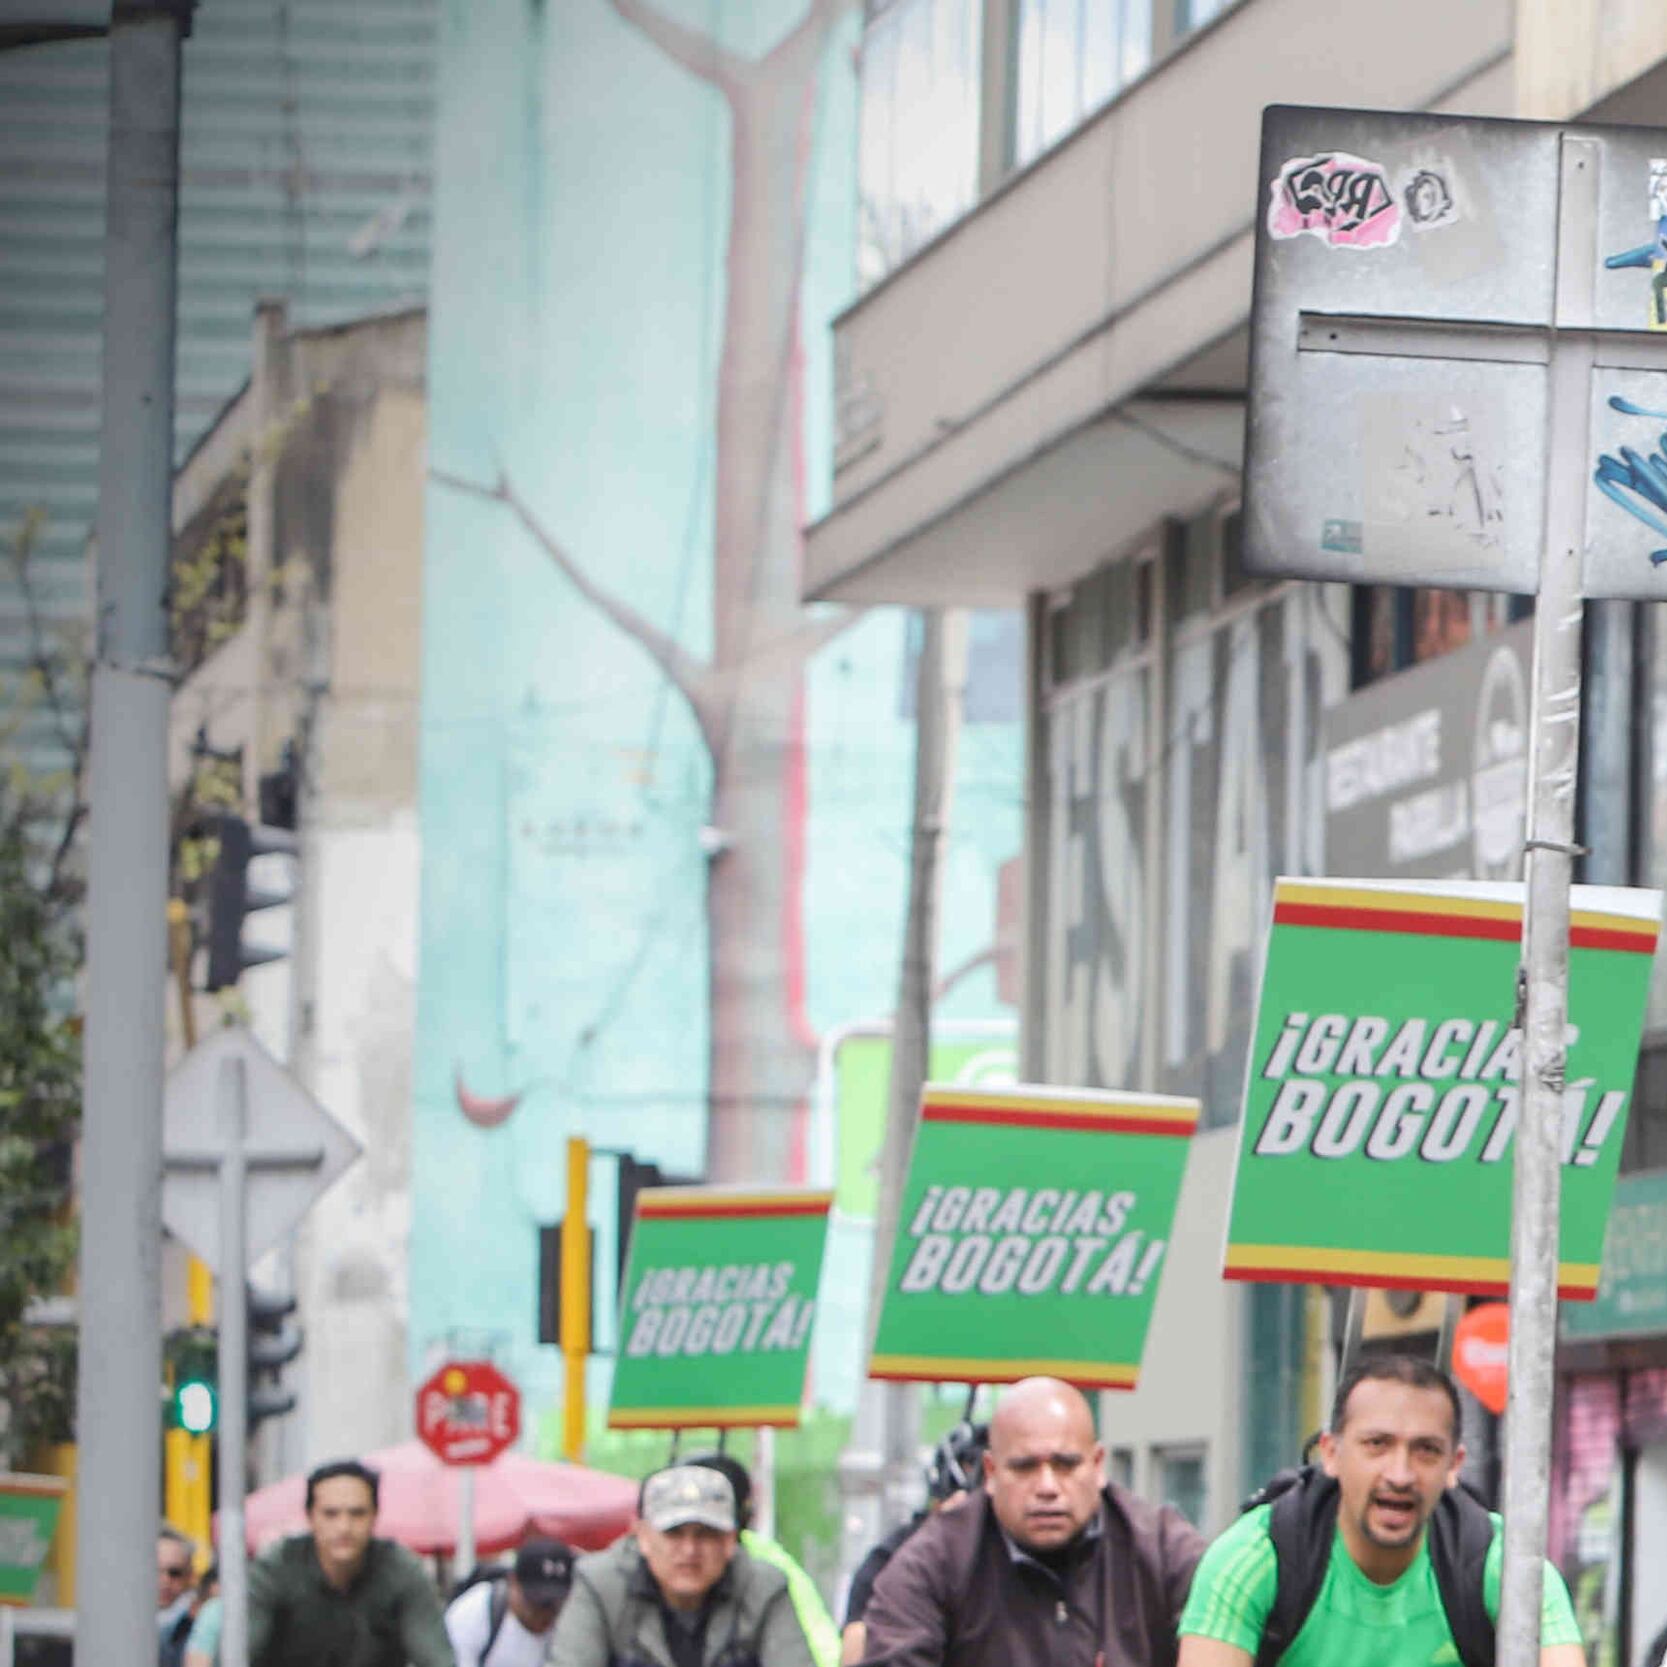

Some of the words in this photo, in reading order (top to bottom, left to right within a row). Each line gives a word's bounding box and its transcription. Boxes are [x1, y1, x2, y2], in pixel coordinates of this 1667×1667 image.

[1262, 1012, 1579, 1080] ¡GRACIA
[909, 1186, 1136, 1239] ¡GRACIAS
[632, 1261, 795, 1312] ¡GRACIAS
[898, 1230, 1166, 1297] BOGOTÁ!
[625, 1294, 812, 1358] BOGOTÁ!
[425, 1391, 512, 1438] PE
